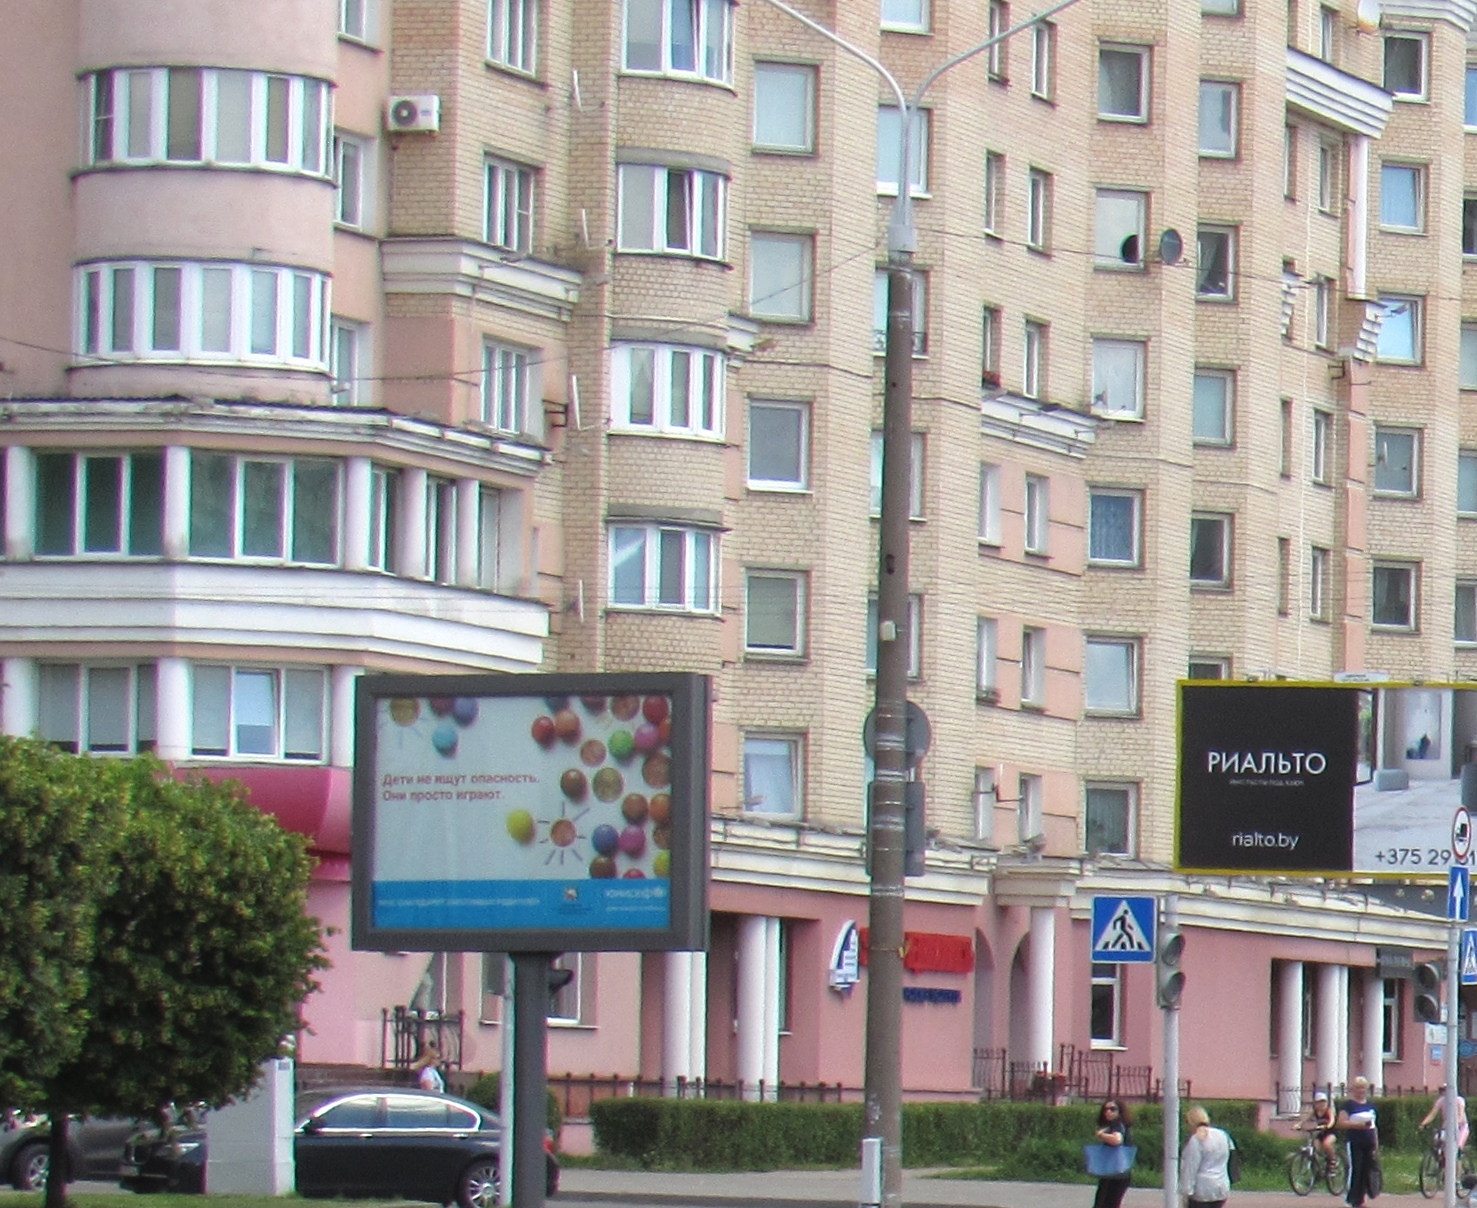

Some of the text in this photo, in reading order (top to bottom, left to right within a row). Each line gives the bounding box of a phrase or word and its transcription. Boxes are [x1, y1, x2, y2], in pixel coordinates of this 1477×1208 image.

[1208, 752, 1327, 775] РИАЛЬТО
[383, 774, 540, 787] Дети не ищут опасность.
[383, 790, 407, 800] Они
[410, 791, 453, 802] просто
[1232, 832, 1299, 850] rialto.by
[1375, 849, 1422, 865] +375
[1428, 849, 1451, 865] 29
